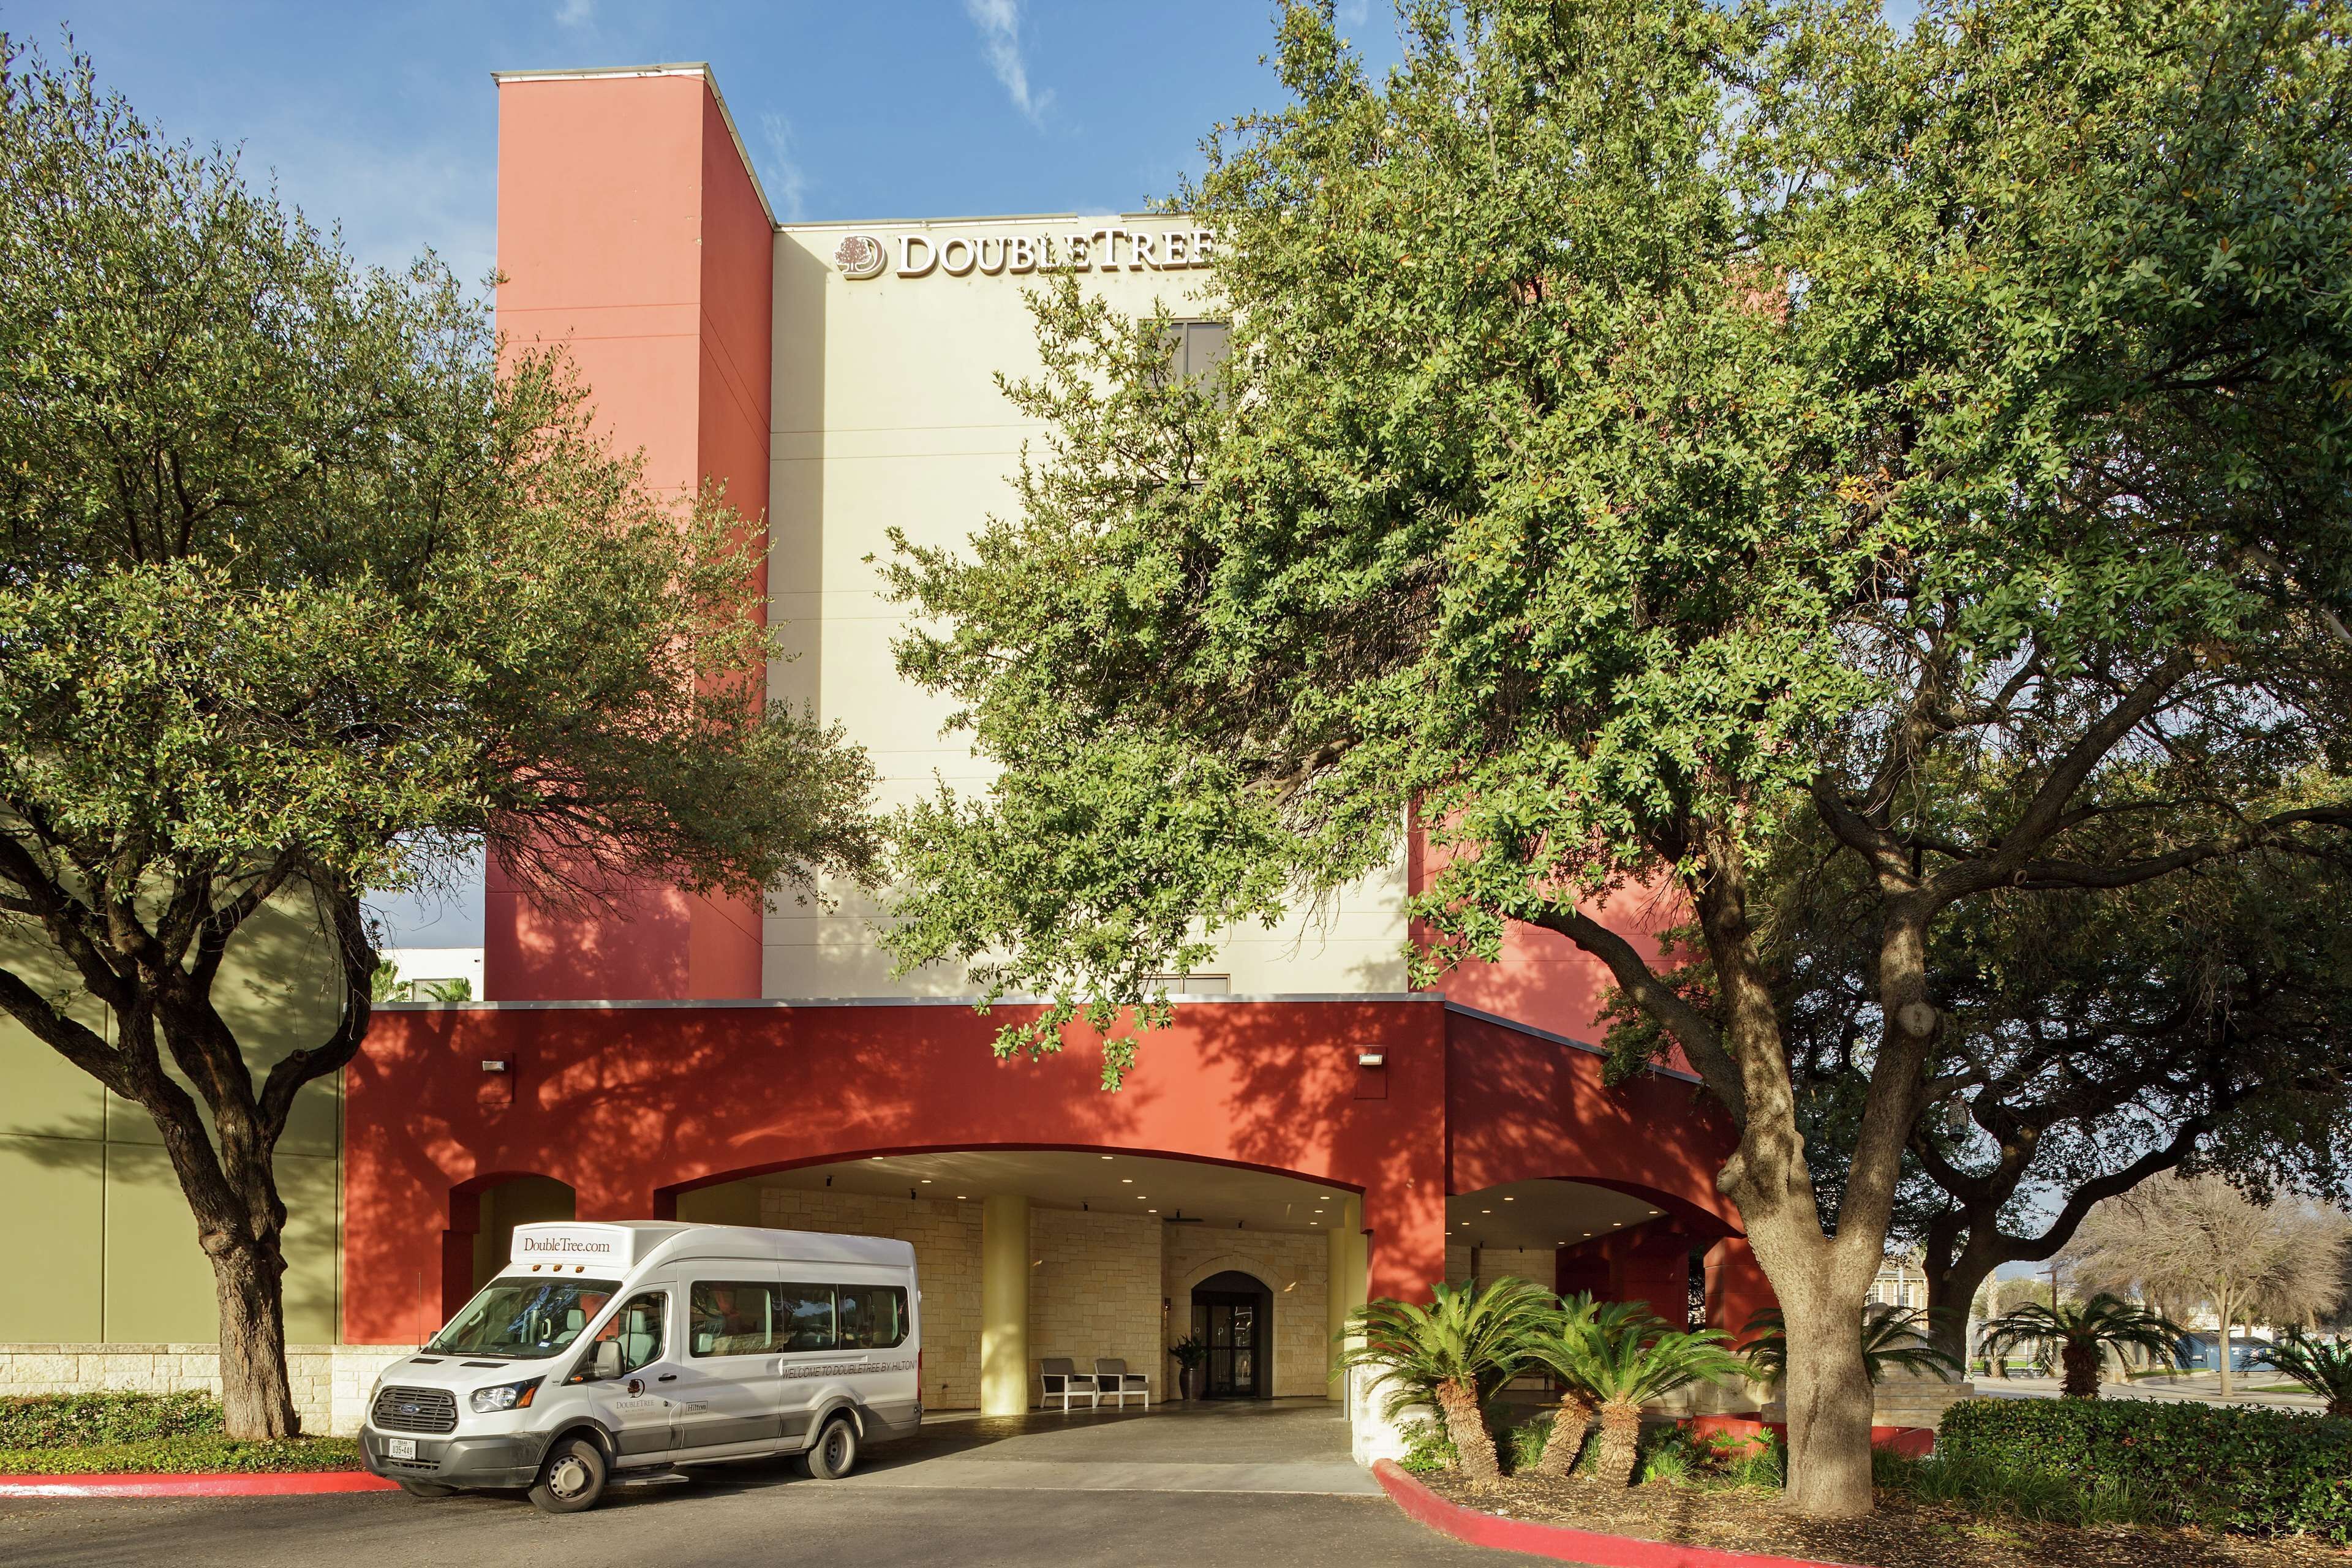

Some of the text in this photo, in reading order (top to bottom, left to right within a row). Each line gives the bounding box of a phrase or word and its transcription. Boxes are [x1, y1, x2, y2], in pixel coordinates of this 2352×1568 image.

[896, 227, 1216, 279] DOUBLETREE
[524, 1238, 610, 1253] DoubleTree.com
[783, 1360, 914, 1379] WELCOME TO DOUBLETREE BY HILTON
[617, 1400, 655, 1409] DOUBLETREE
